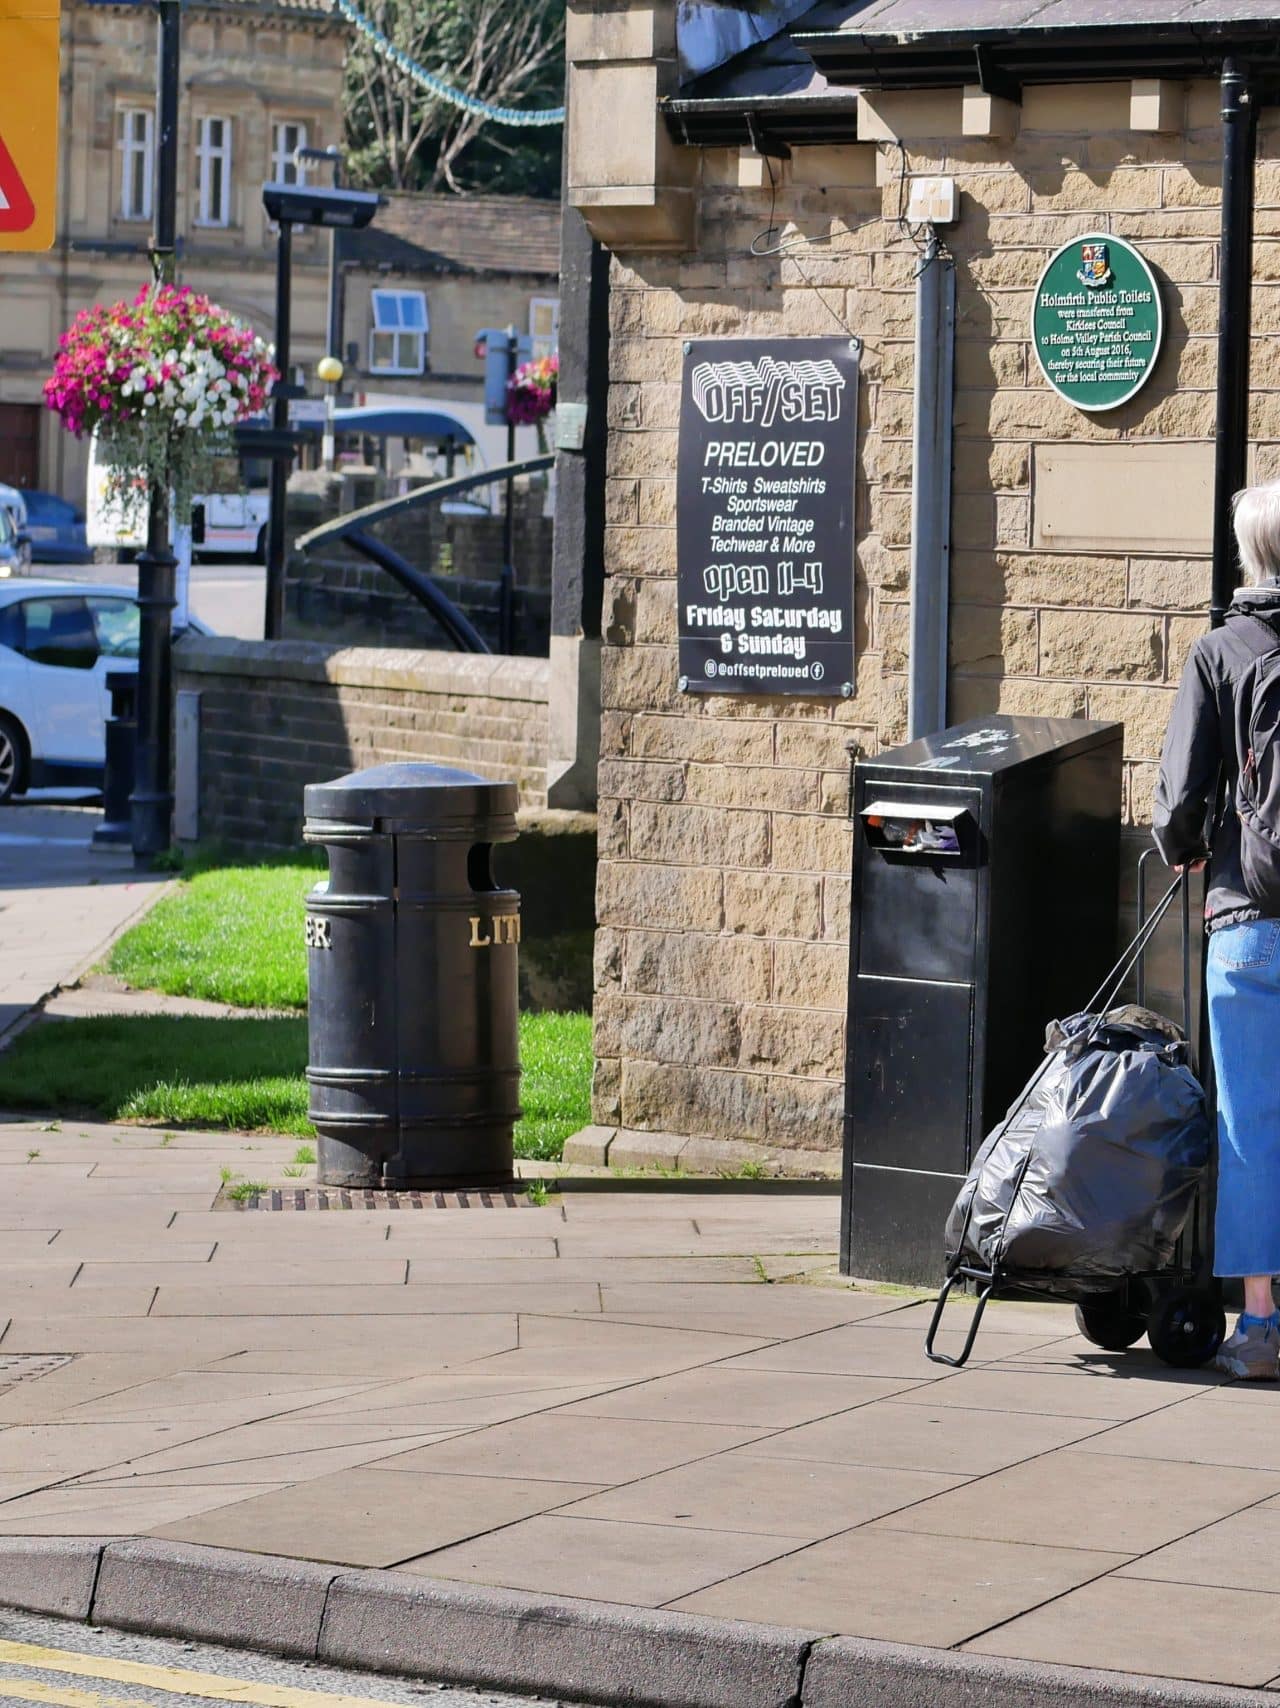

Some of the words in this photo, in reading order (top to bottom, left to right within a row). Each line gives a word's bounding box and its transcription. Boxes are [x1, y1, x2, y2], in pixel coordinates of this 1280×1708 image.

[1040, 292, 1085, 307] Holmfirth
[1087, 290, 1118, 305] Public
[1119, 289, 1151, 303] Toilets
[1058, 309, 1075, 318] were
[1076, 306, 1114, 318] transferred
[1115, 305, 1134, 316] from
[1066, 320, 1096, 331] Kirklees
[1097, 318, 1126, 329] Council
[1041, 335, 1049, 345] to
[1050, 333, 1074, 345] Holme
[1075, 332, 1099, 345] Valley
[1099, 331, 1122, 343] Parish
[1123, 330, 1152, 341] Council
[1061, 348, 1070, 357] on
[1084, 345, 1110, 358] August
[1048, 359, 1074, 371] thereby
[1075, 358, 1105, 370] securing
[1106, 357, 1124, 368] their
[1124, 356, 1146, 367] future
[1055, 371, 1066, 383] for
[1067, 371, 1079, 382] the
[1079, 370, 1097, 381] local
[1098, 369, 1139, 382] community
[692, 356, 846, 427] OFF/SET
[704, 441, 825, 467] PRELOVED
[701, 476, 748, 494] T-Shirts
[753, 475, 826, 494] Sweatshirts
[727, 495, 798, 516] Sportswear
[712, 515, 765, 532] Branded
[768, 515, 814, 536] Vintage
[710, 535, 768, 553] Techwear
[770, 536, 780, 553] &
[782, 536, 816, 553] More
[703, 563, 769, 601] open
[686, 604, 746, 631] Friday
[750, 605, 843, 633] Saturday
[738, 633, 806, 660] Sunday
[718, 662, 809, 679] @offsetpreloved
